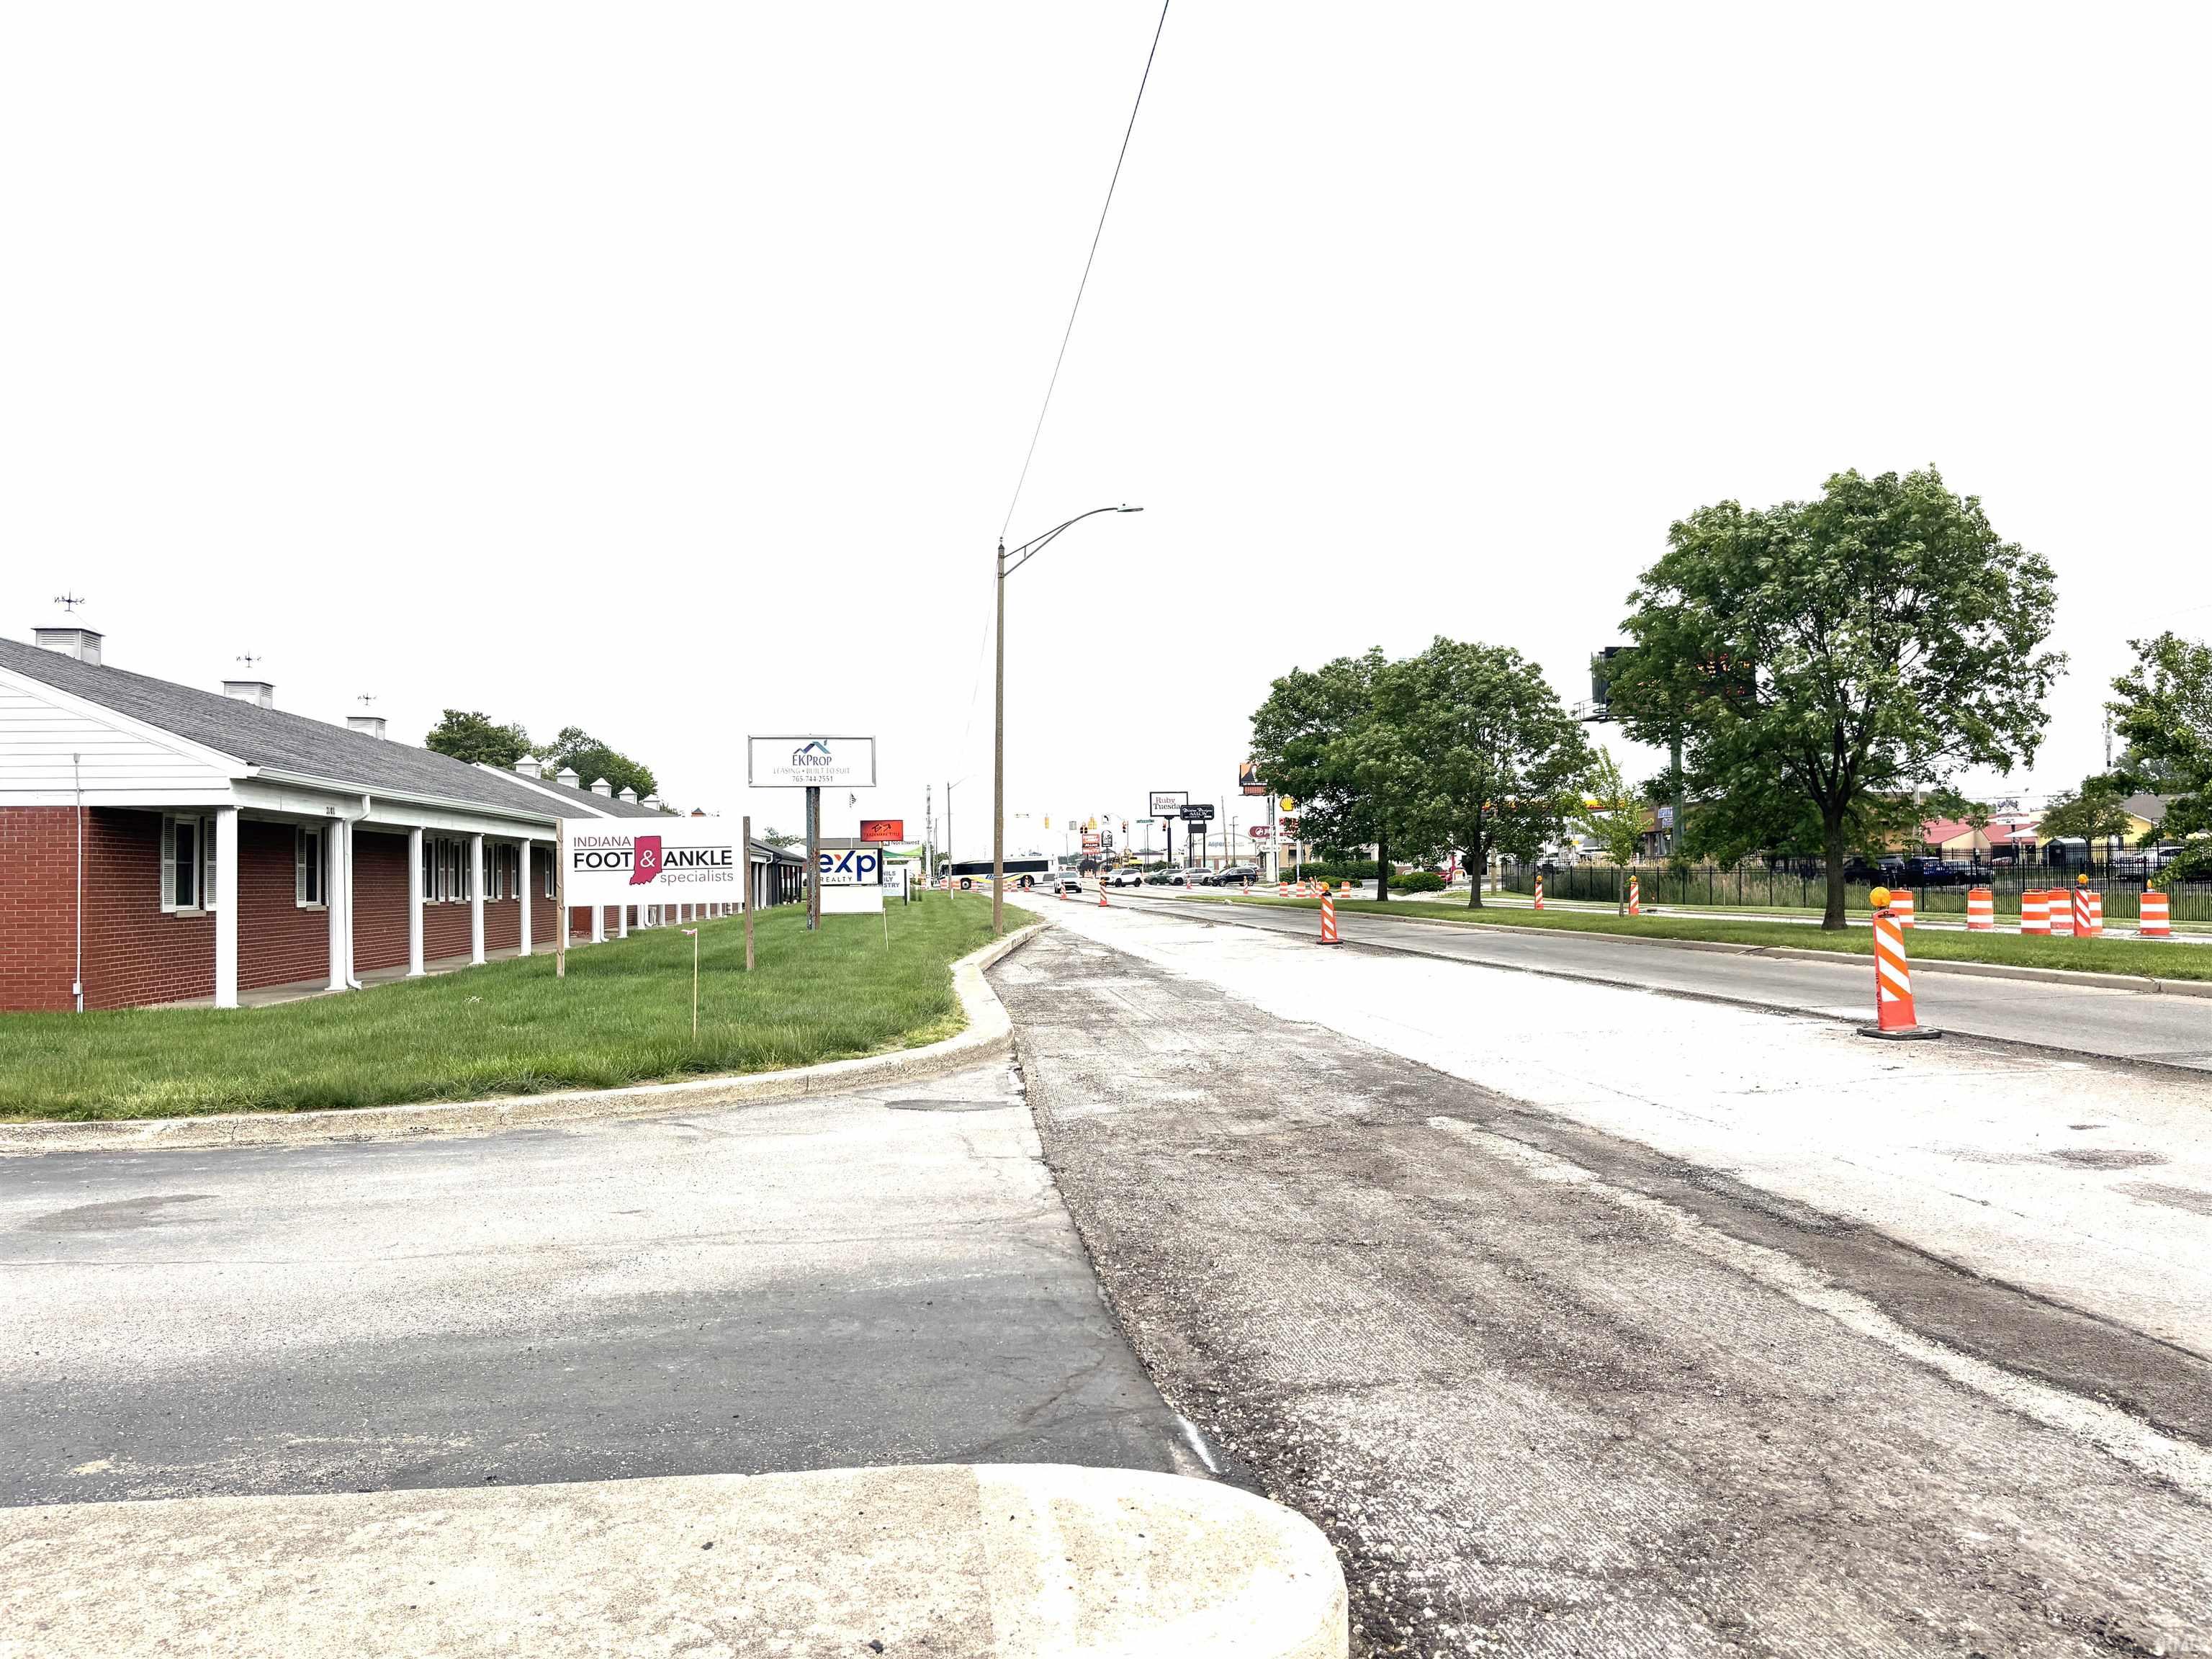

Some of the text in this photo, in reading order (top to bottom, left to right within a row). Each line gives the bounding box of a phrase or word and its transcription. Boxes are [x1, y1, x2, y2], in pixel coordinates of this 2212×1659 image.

[574, 836, 631, 847] INDIANA
[574, 850, 732, 868] FOOT & ANKLE
[660, 870, 734, 886] specialists
